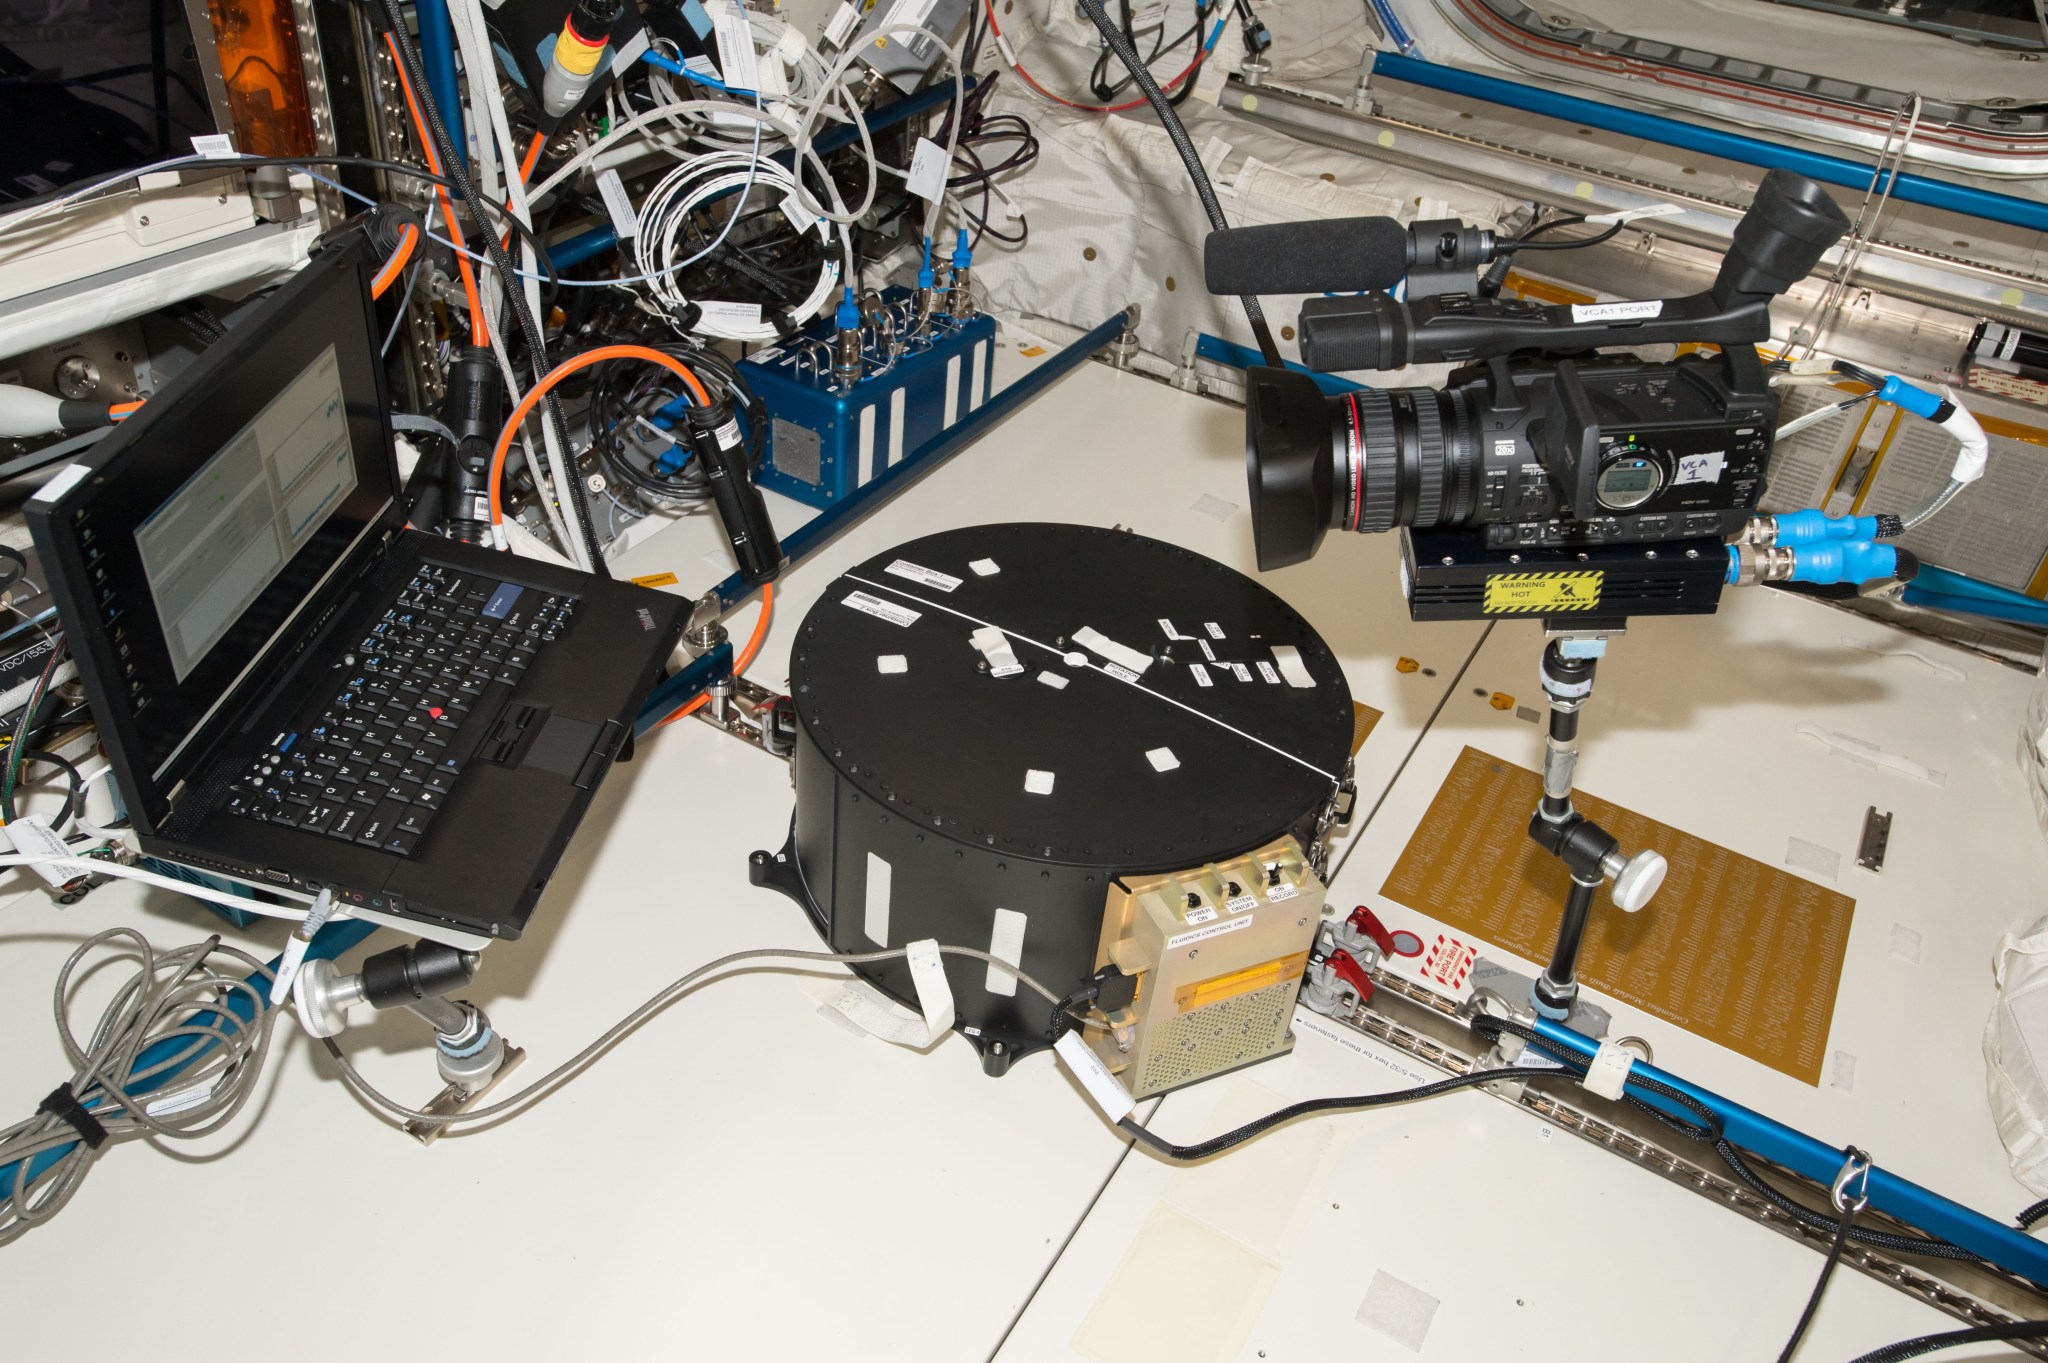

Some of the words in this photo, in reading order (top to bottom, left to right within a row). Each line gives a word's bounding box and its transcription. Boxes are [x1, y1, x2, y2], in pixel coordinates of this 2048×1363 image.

[1579, 306, 1615, 318] VCA1
[1618, 303, 1658, 316] PORT
[1980, 376, 2008, 387] FIRE
[2011, 383, 2046, 397] PORT
[1681, 459, 1708, 471] VCA
[1686, 469, 1703, 481] 1
[895, 560, 926, 575] Container
[925, 568, 938, 577] Box
[1500, 581, 1546, 589] WARNING
[866, 606, 879, 617] Box
[877, 611, 910, 626] Container
[1108, 662, 1139, 680] ROTATION
[1112, 669, 1129, 680] HOLE
[339, 766, 350, 775] W
[1271, 890, 1298, 901] RECORD
[1274, 885, 1285, 893] ON
[1226, 896, 1253, 908] SYSTEM
[1231, 901, 1256, 913] ON/OFF
[1186, 908, 1212, 919] POWER
[1171, 932, 1201, 945] FLUIDICS
[1201, 924, 1233, 938] CONTROL
[1233, 918, 1250, 930] UNIT
[1447, 946, 1459, 960] FIRE
[1491, 934, 1533, 960] Engineers
[1439, 959, 1452, 977] PORT
[1575, 968, 1588, 983] By
[1588, 976, 1611, 994] Built
[1611, 988, 1646, 1011] Module
[1649, 1003, 1689, 1024] Columbus
[1303, 1020, 1339, 1045] fasteners
[1339, 1037, 1361, 1055] these
[1362, 1049, 1374, 1060] for
[1375, 1055, 1388, 1067] hex
[1389, 1061, 1408, 1077] 5/32
[1409, 1072, 1427, 1085] Use
